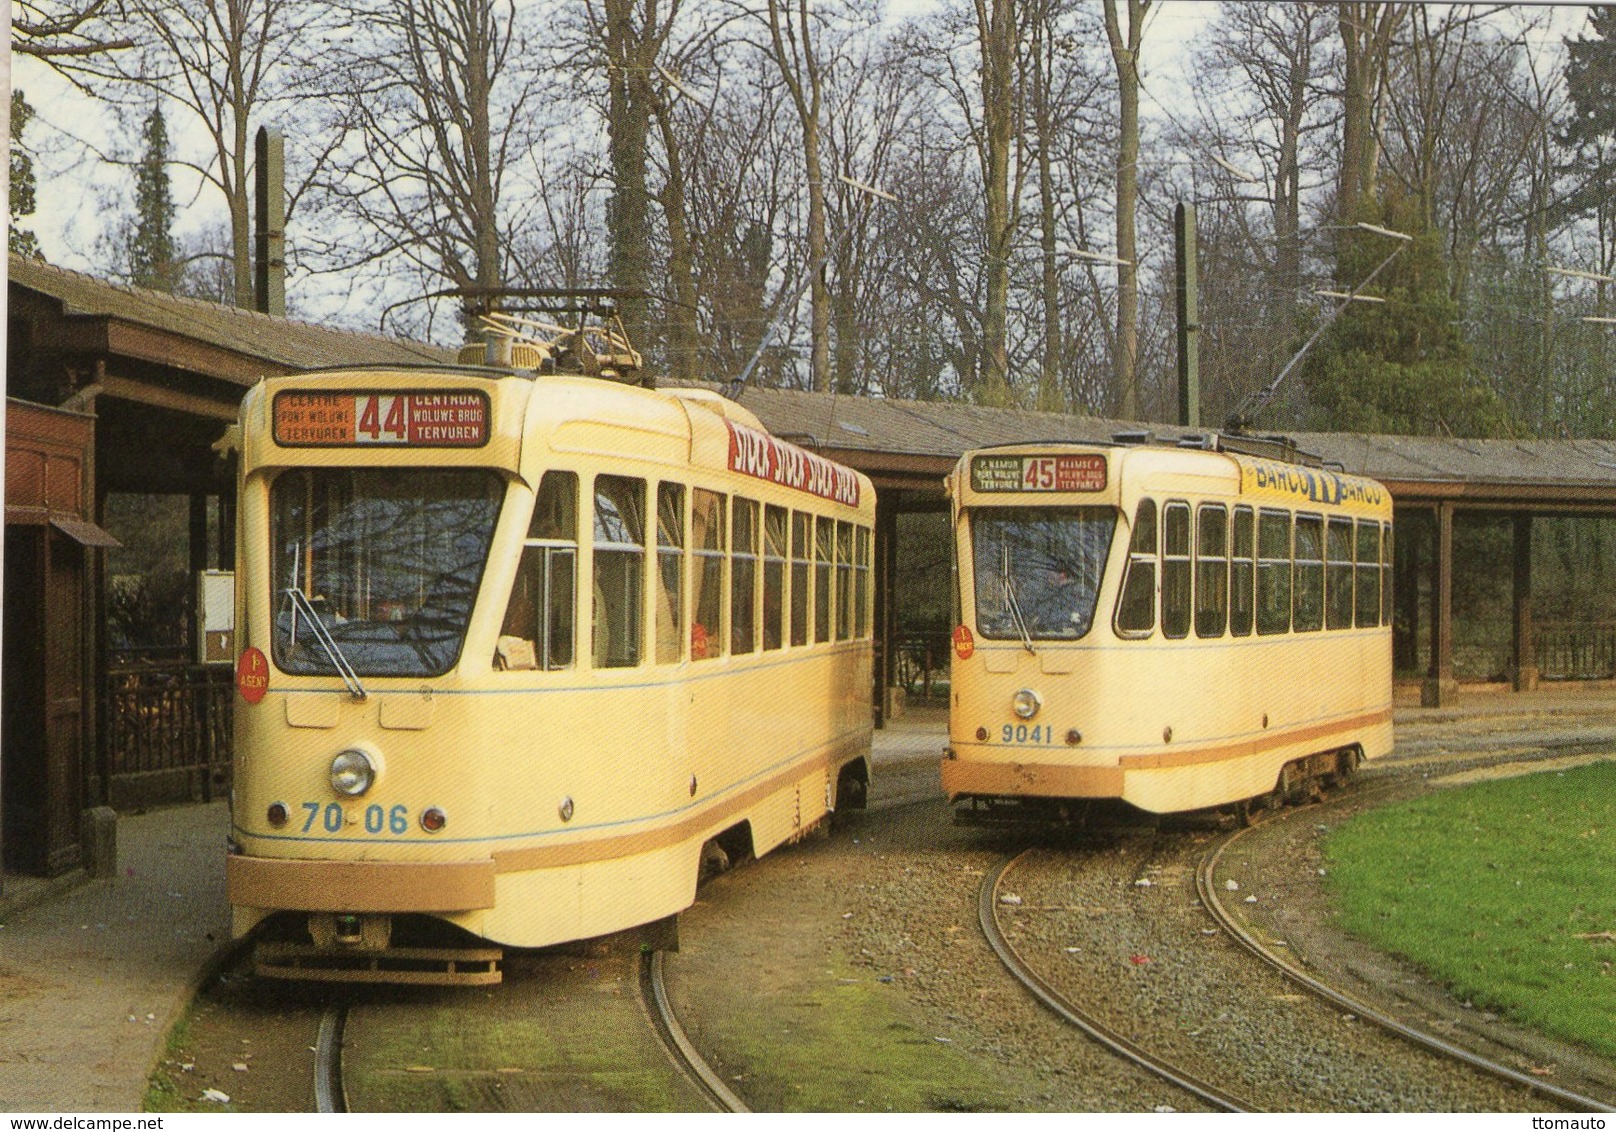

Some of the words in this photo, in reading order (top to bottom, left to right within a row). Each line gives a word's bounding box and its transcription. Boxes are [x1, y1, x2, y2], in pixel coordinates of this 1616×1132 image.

[415, 394, 480, 406] CENTRUM
[358, 394, 408, 440] 44
[413, 409, 455, 423] WOLUWE
[457, 409, 483, 423] BRUG
[286, 427, 347, 440] TERVUREN
[417, 426, 480, 439] TERVUREN
[1025, 459, 1055, 489] 45
[1002, 724, 1052, 744] 9041
